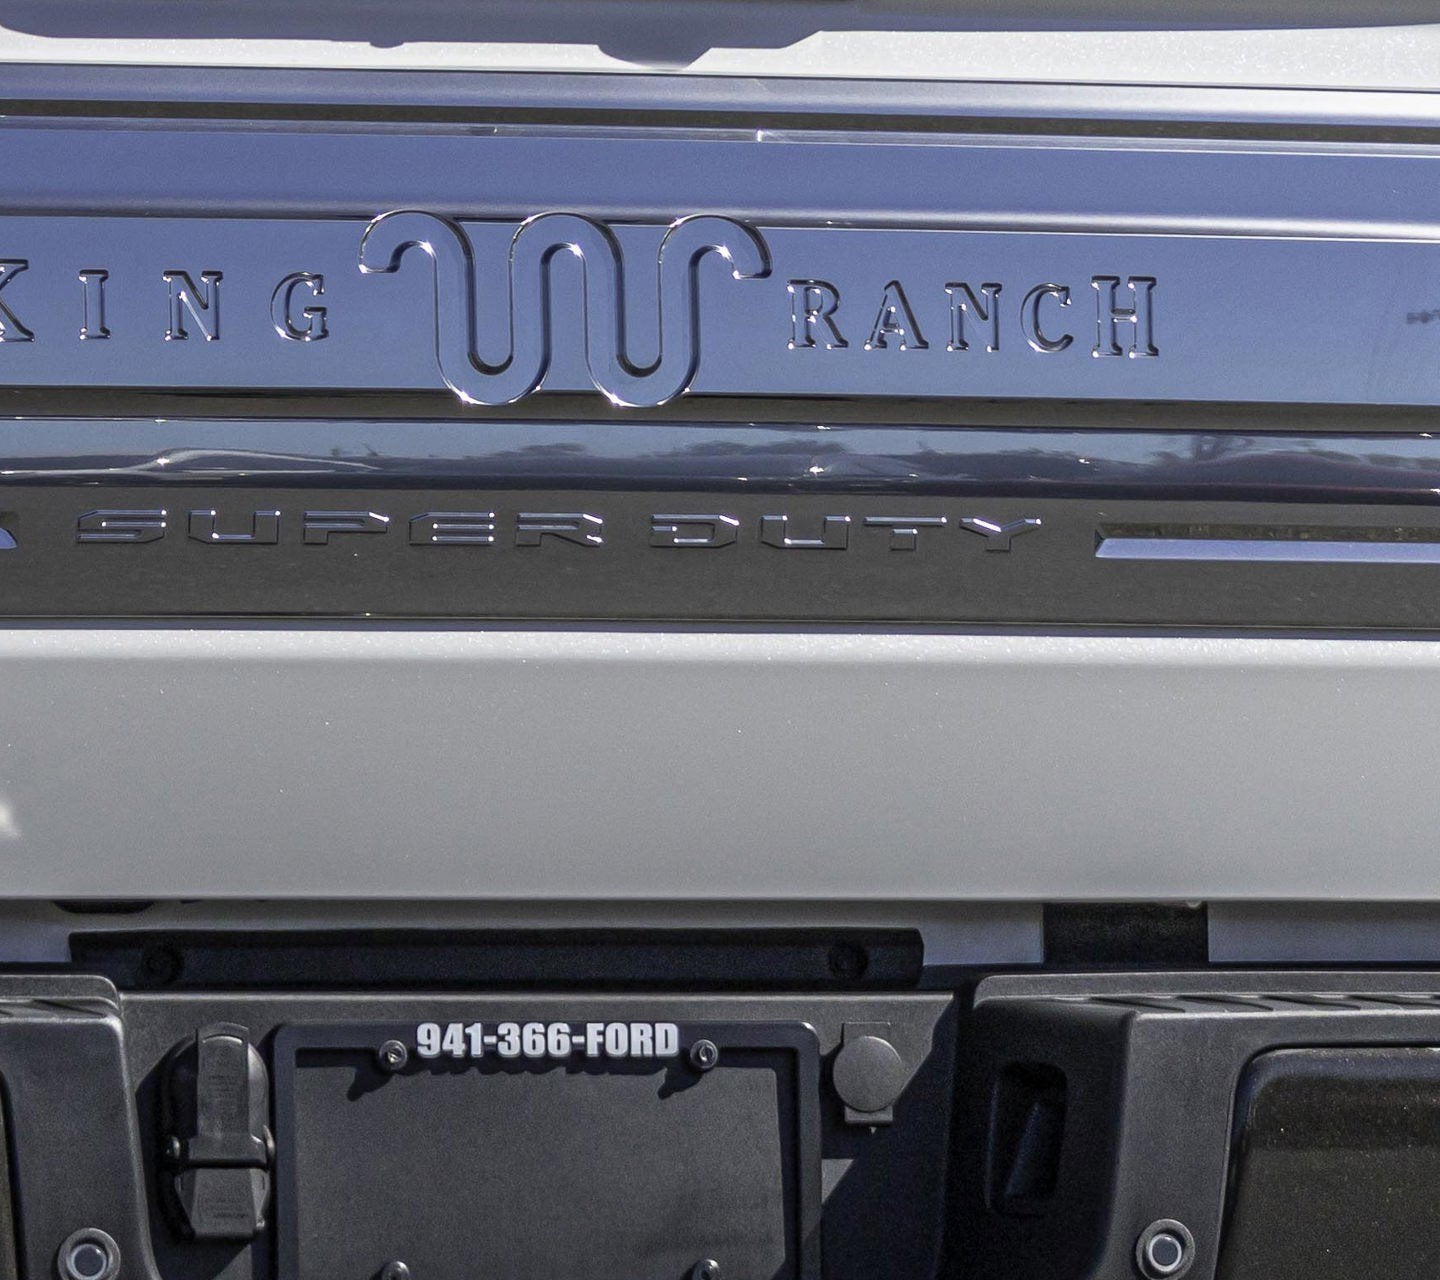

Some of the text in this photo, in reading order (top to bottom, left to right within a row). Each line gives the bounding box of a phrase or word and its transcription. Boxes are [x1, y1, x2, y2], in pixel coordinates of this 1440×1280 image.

[787, 275, 1160, 358] RANCH
[77, 509, 1042, 553] SUPER DUTY
[416, 1022, 680, 1058] 941-366-FORD
